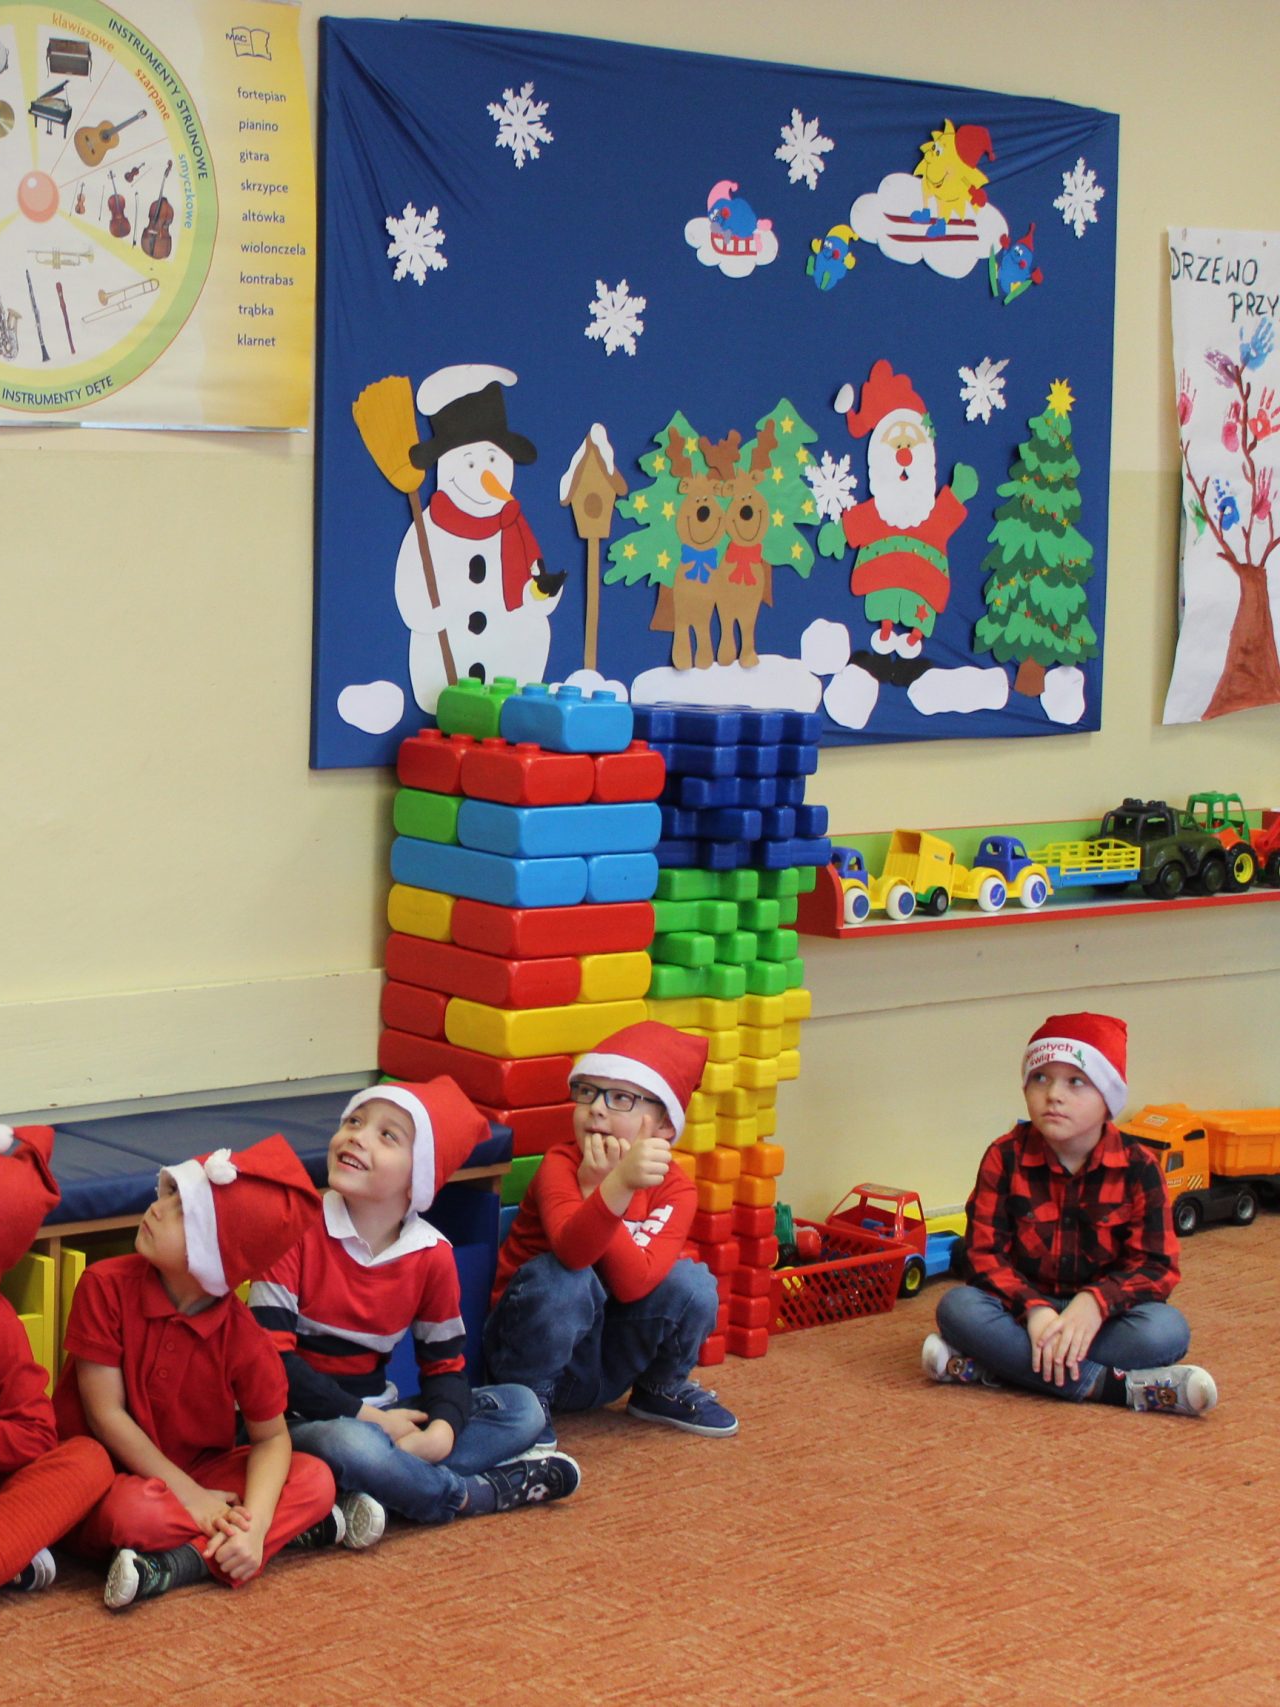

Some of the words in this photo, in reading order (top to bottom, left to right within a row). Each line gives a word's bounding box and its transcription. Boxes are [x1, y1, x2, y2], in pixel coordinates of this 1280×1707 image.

[52, 13, 114, 53] klawiszowe
[108, 18, 180, 96] INSTRUMENTY
[176, 99, 208, 180] STRUNOWE
[135, 69, 171, 121] szarpane
[237, 86, 287, 103] fortepian
[238, 119, 279, 132] pianino
[239, 149, 270, 163] gitara
[178, 153, 196, 229] smyczkowe
[240, 179, 289, 194] skrzypce
[241, 209, 286, 224] altówka
[240, 241, 306, 256] wiolonczela
[1170, 246, 1258, 287] DRZEWO
[239, 272, 294, 287] kontrabas
[238, 303, 274, 318] trąbka
[237, 333, 276, 347] klarnet
[2, 387, 82, 405] INSTRUMENTY
[85, 375, 114, 396] DĘTE
